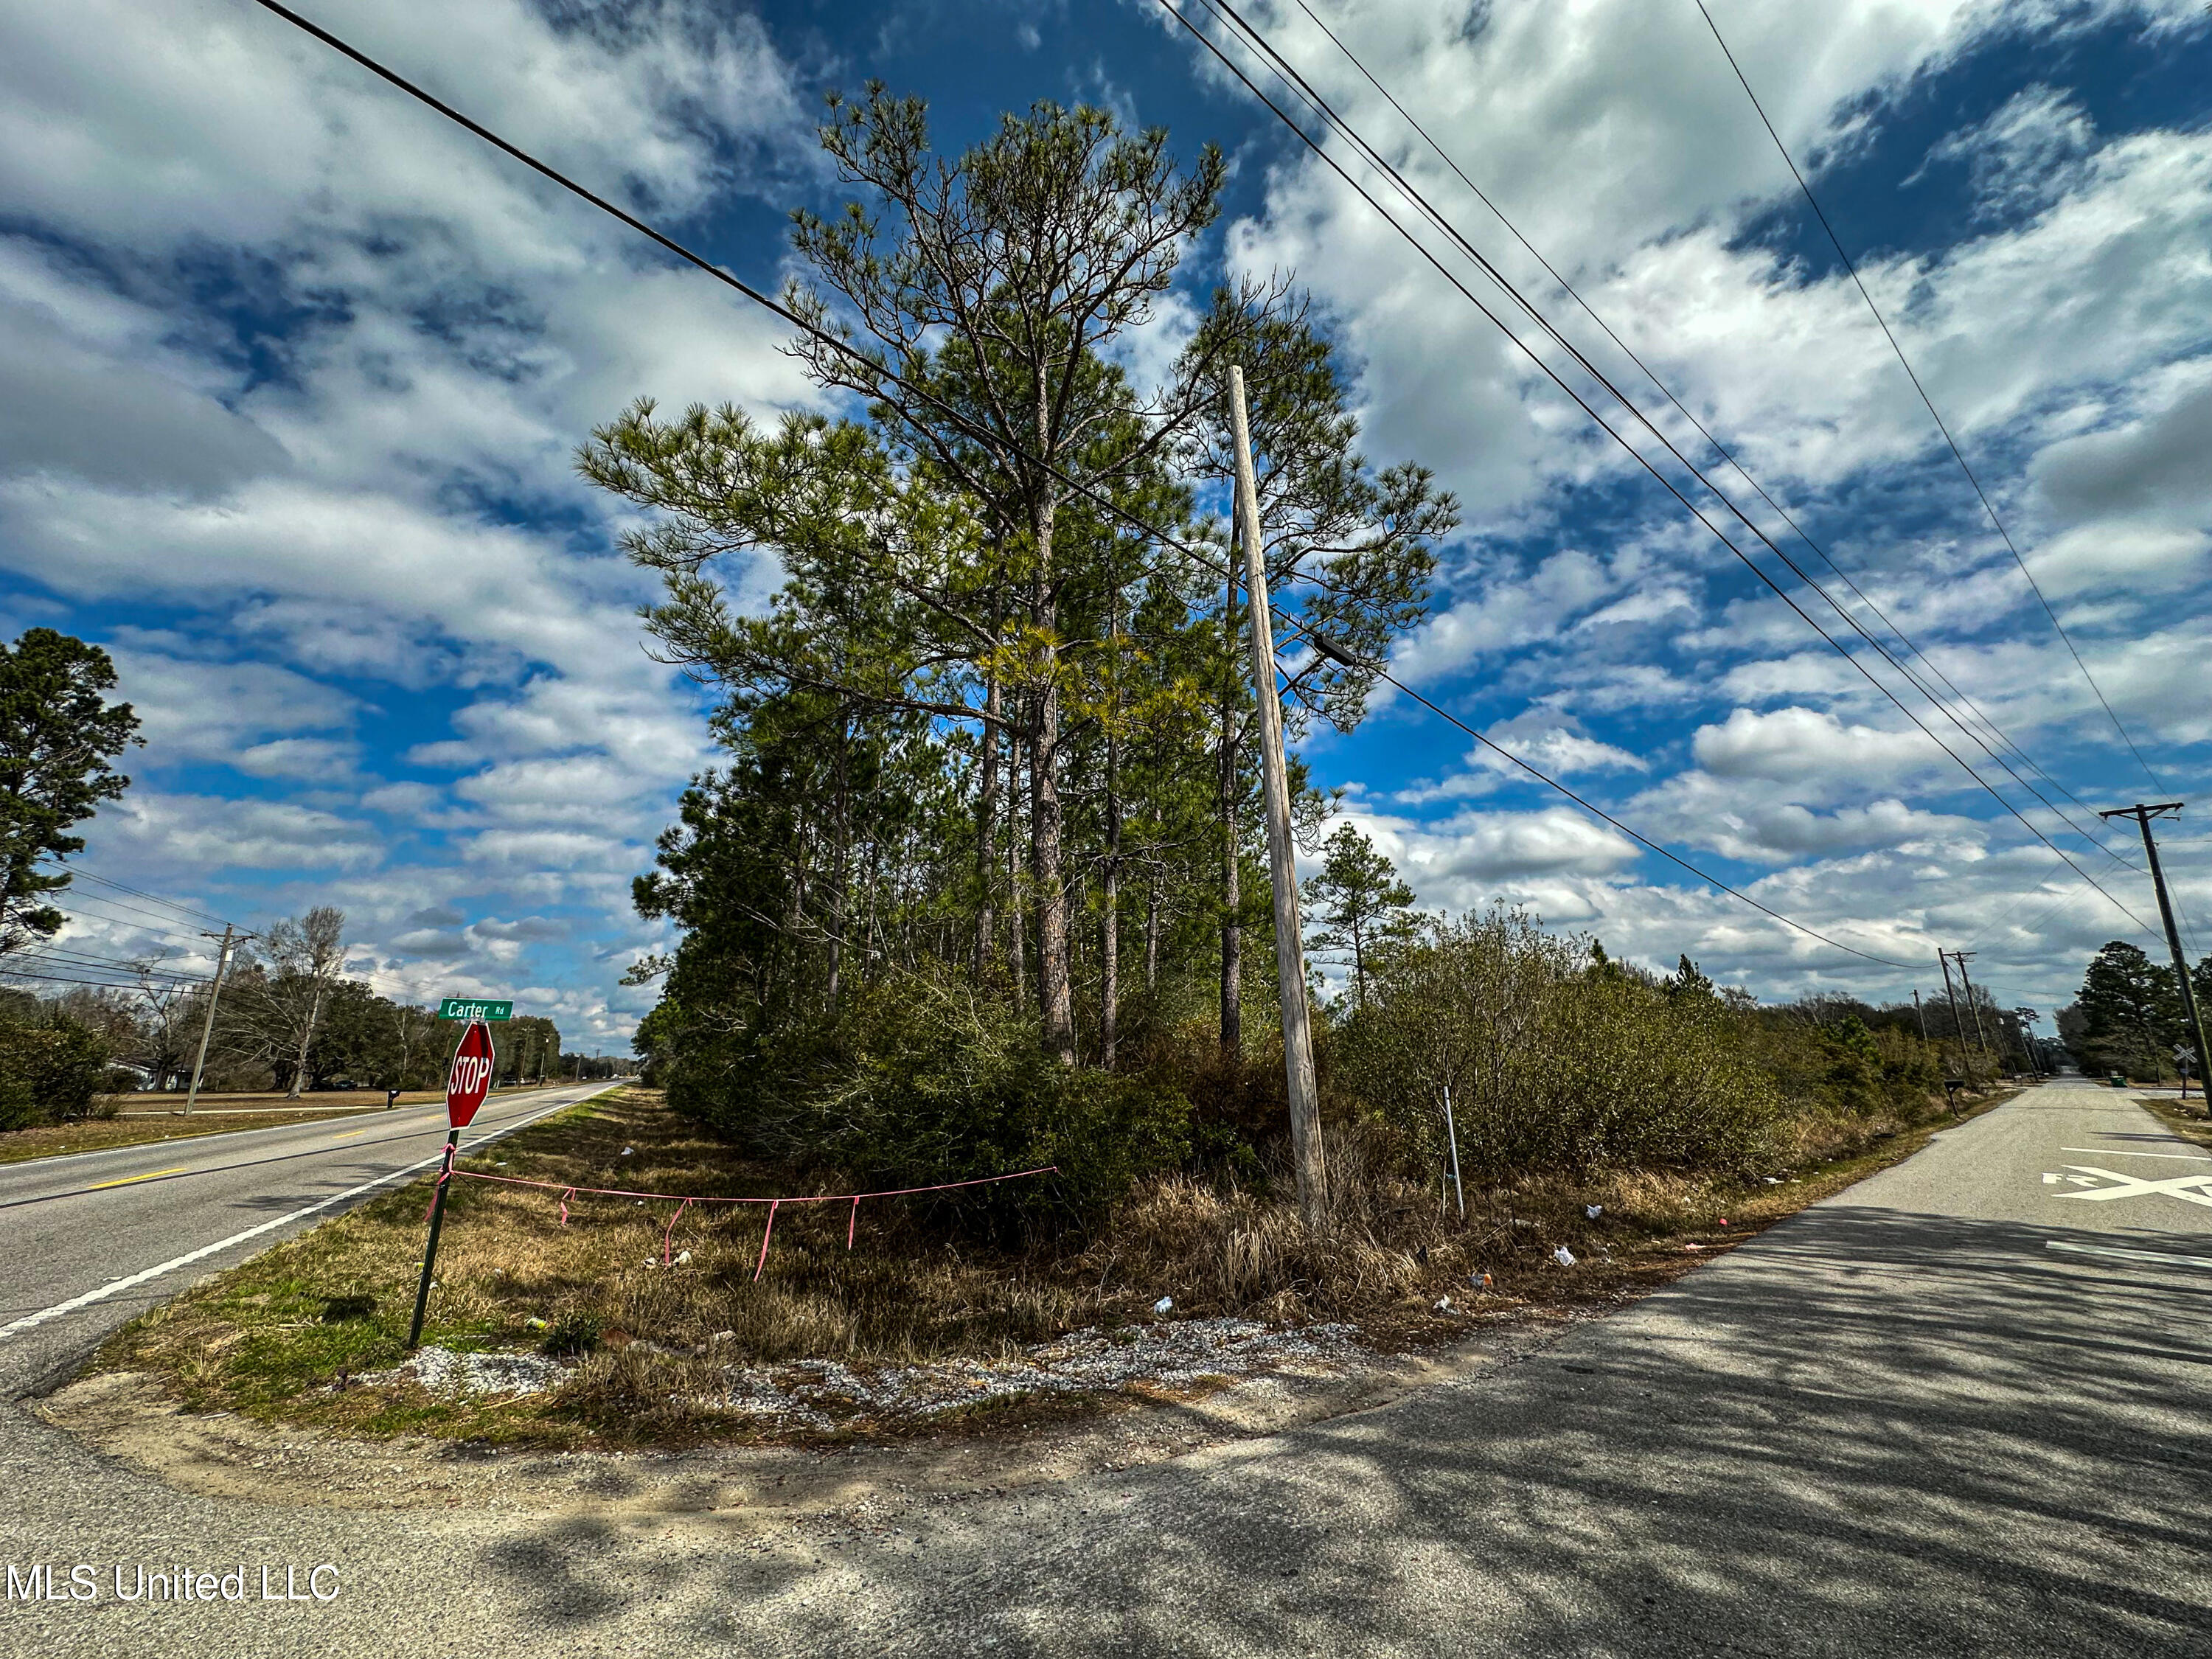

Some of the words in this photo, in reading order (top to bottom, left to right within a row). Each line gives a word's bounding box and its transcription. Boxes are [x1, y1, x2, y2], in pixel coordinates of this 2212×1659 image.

[448, 1001, 488, 1018] Carter
[495, 1006, 504, 1015] Rd
[451, 1056, 490, 1095] STOP
